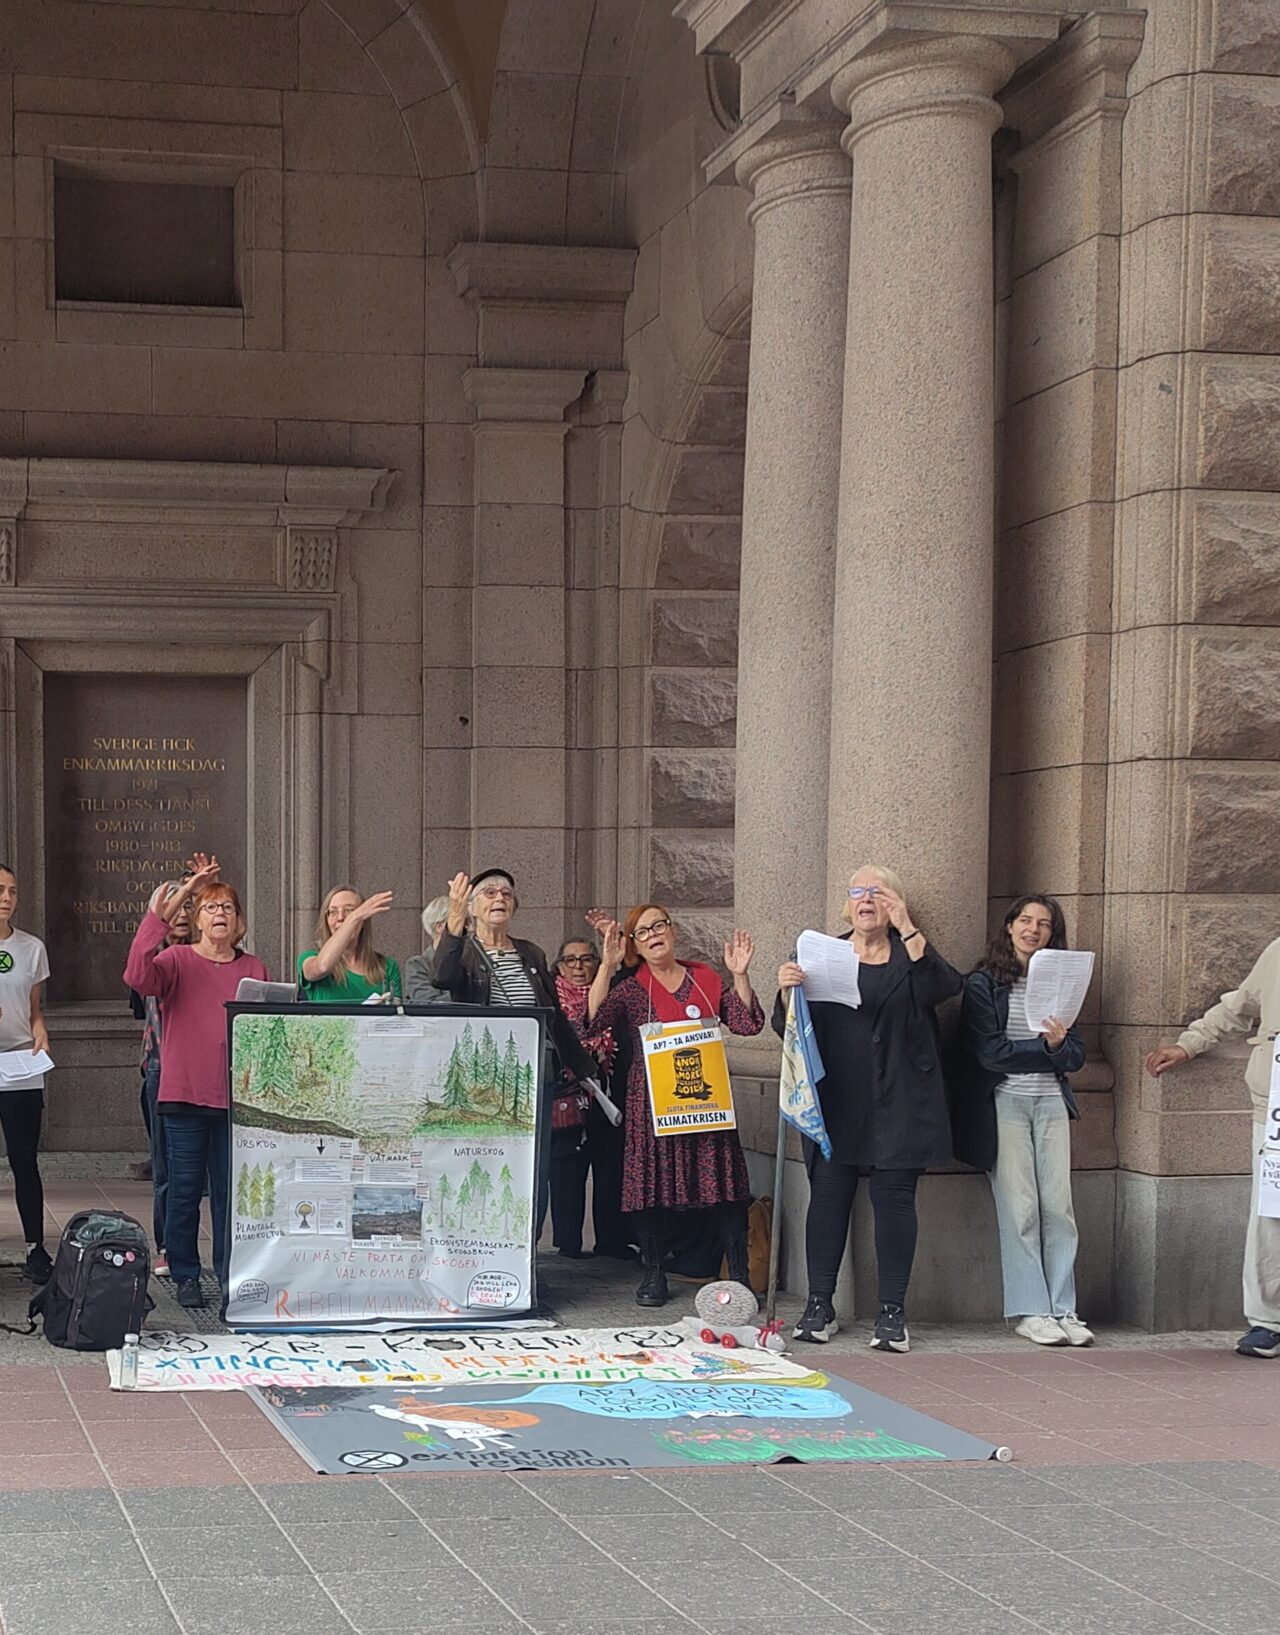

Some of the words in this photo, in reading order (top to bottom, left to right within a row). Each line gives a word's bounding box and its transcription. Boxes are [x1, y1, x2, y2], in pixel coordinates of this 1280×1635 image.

[93, 738, 158, 751] SVERIGE
[162, 738, 196, 751] FICK
[63, 758, 226, 771] ENKAMMARRIKSDAG
[131, 779, 158, 791] 1971
[79, 798, 110, 811] TILL
[114, 798, 153, 811] DESS
[95, 820, 196, 833] OMBYGGDES
[96, 860, 187, 873] RIKSDAGEN
[89, 920, 120, 934] TILL
[653, 1040, 667, 1050] AP7
[674, 1038, 684, 1046] TA
[685, 1030, 715, 1043] ANSVAR!
[657, 1111, 727, 1127] KLIMATKRISEN
[236, 1140, 277, 1150] URSKOG
[453, 1147, 504, 1157] NATURSKOG
[236, 1222, 276, 1233] PLANTAGE
[293, 1252, 306, 1262] VI
[312, 1250, 357, 1263] MÅSTE
[368, 1252, 404, 1264] PRATA
[411, 1252, 427, 1264] OM
[432, 1257, 485, 1268] SKOGEN!
[411, 1449, 594, 1461] extinction
